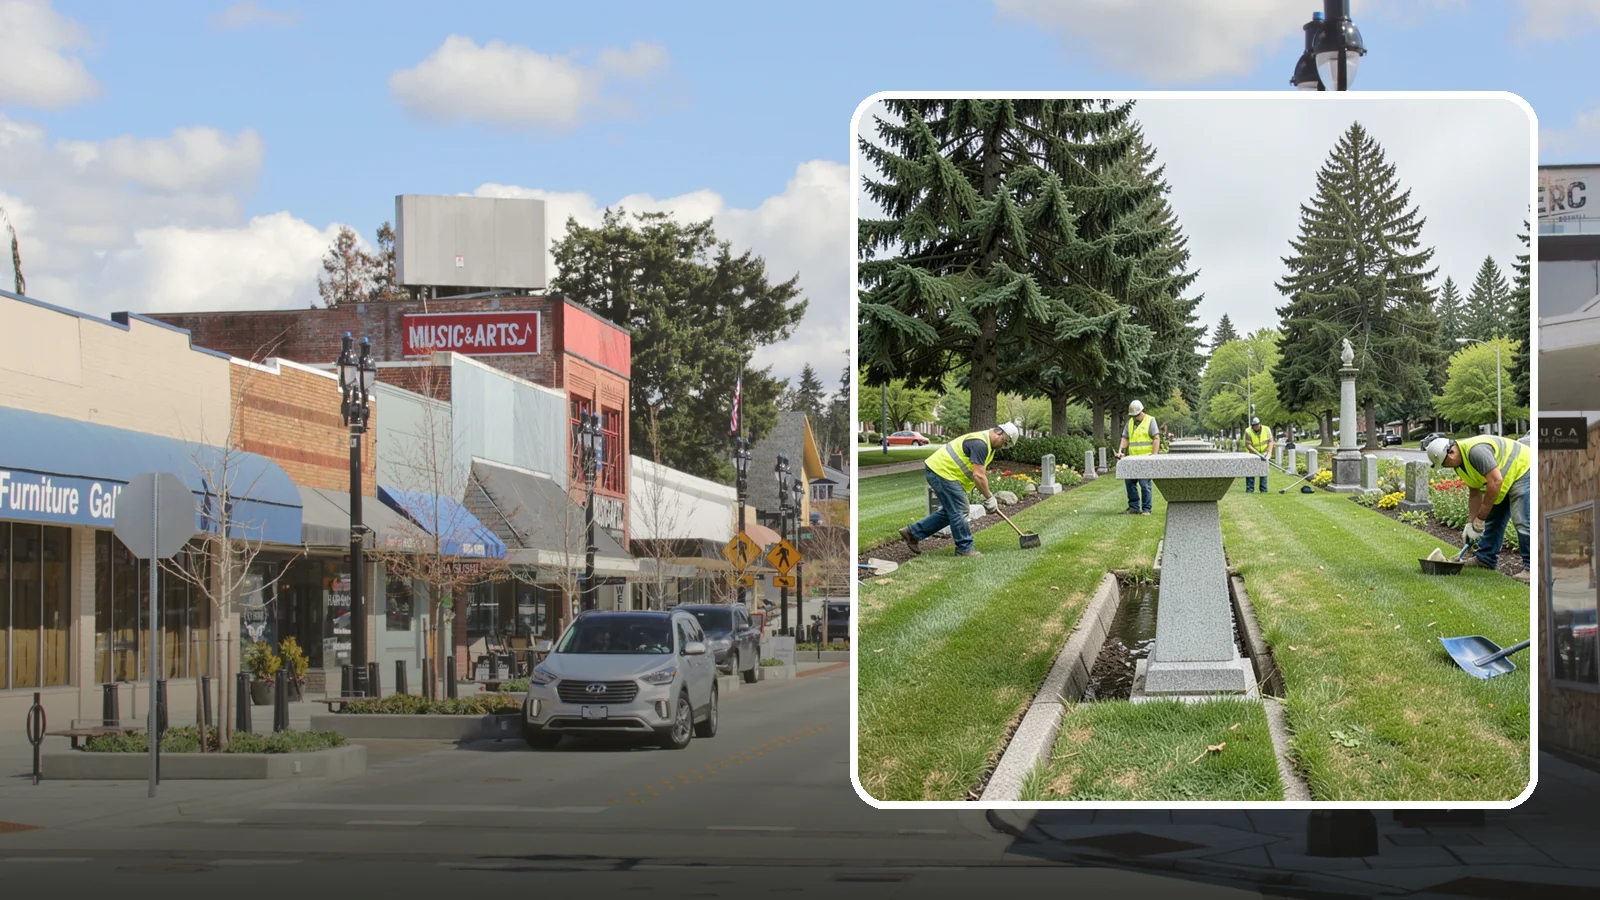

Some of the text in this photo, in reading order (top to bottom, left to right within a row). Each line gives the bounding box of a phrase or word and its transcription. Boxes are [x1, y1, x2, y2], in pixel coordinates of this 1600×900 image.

[409, 323, 519, 348] MUSIC&ARTS
[1540, 428, 1577, 436] UGA
[0, 471, 79, 515] Furniture
[453, 563, 479, 573] SUSHI
